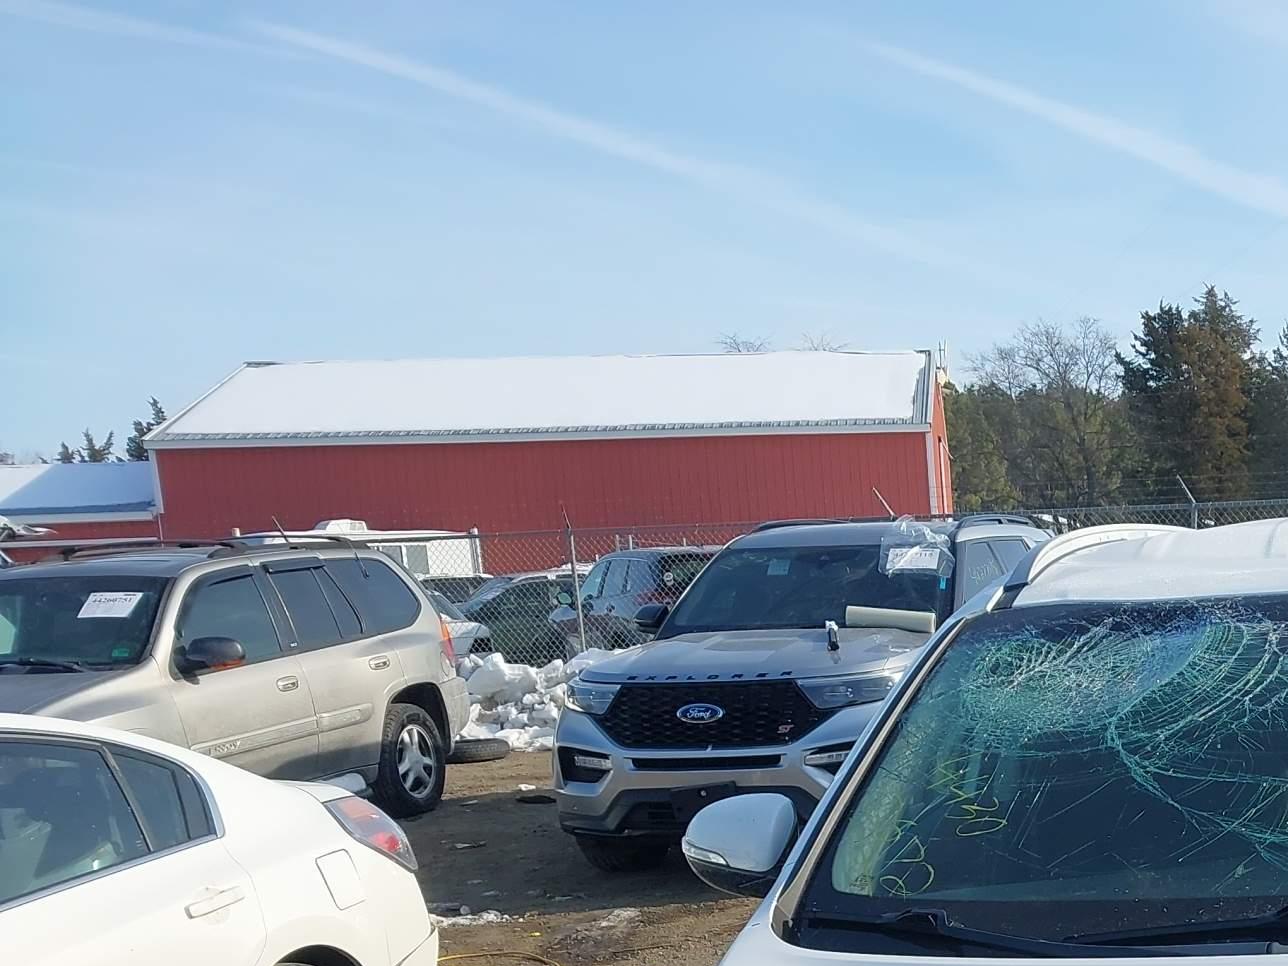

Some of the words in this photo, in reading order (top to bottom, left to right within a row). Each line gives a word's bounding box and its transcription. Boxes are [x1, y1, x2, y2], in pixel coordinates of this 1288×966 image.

[626, 671, 793, 681] EXPLORER
[686, 707, 713, 721] Ford
[777, 724, 794, 733] ST
